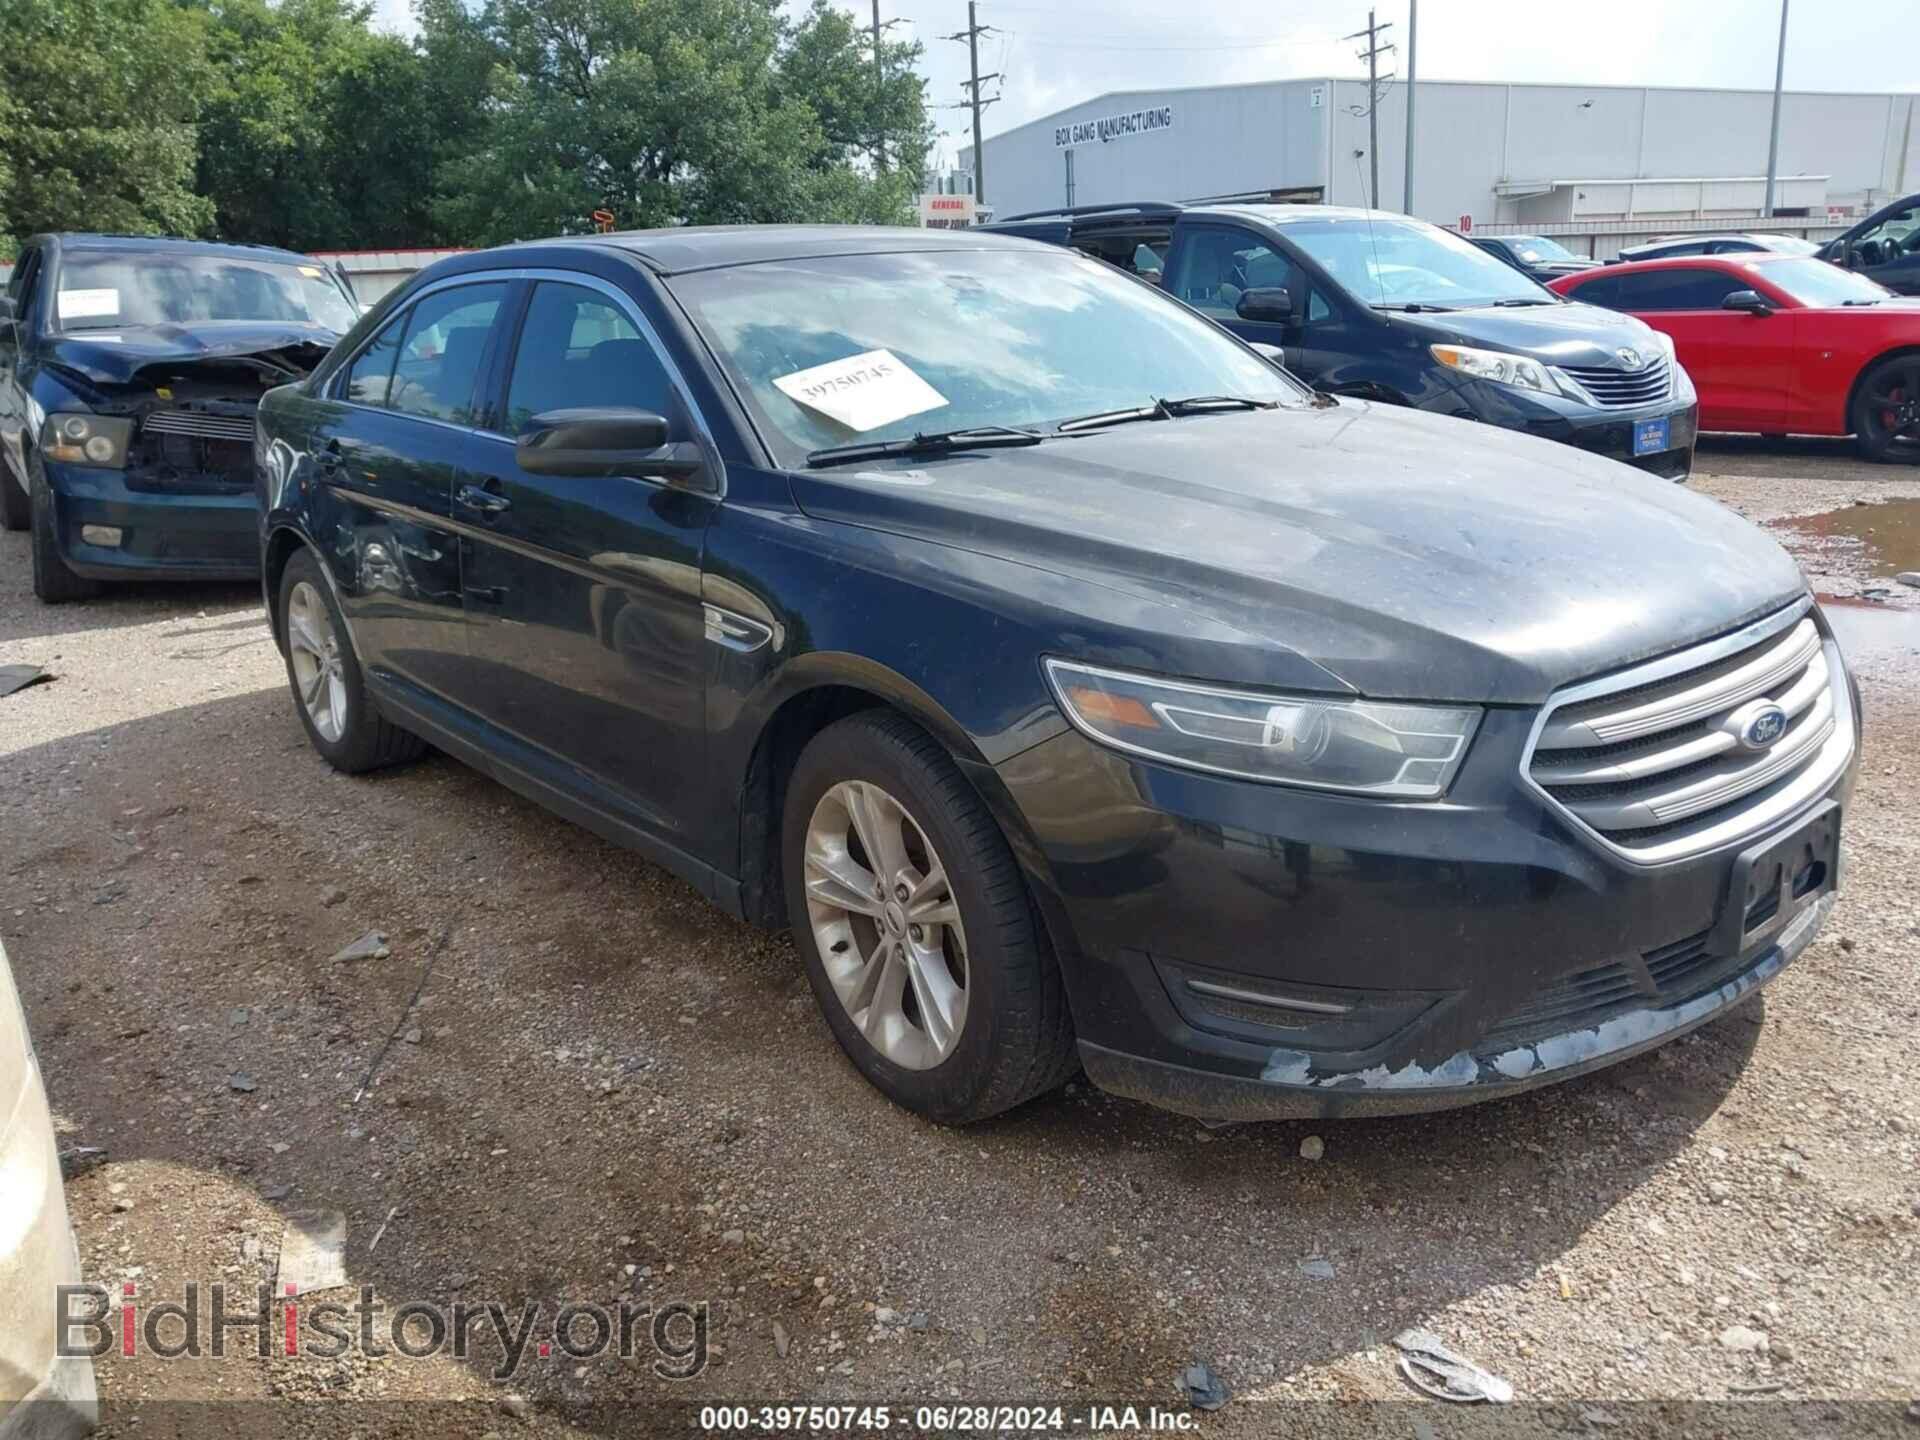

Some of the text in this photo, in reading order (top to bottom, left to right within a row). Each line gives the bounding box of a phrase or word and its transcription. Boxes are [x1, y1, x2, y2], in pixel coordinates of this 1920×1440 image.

[1055, 106, 1171, 146] BOX GANG MANUFACTURING
[1459, 215, 1472, 232] 10
